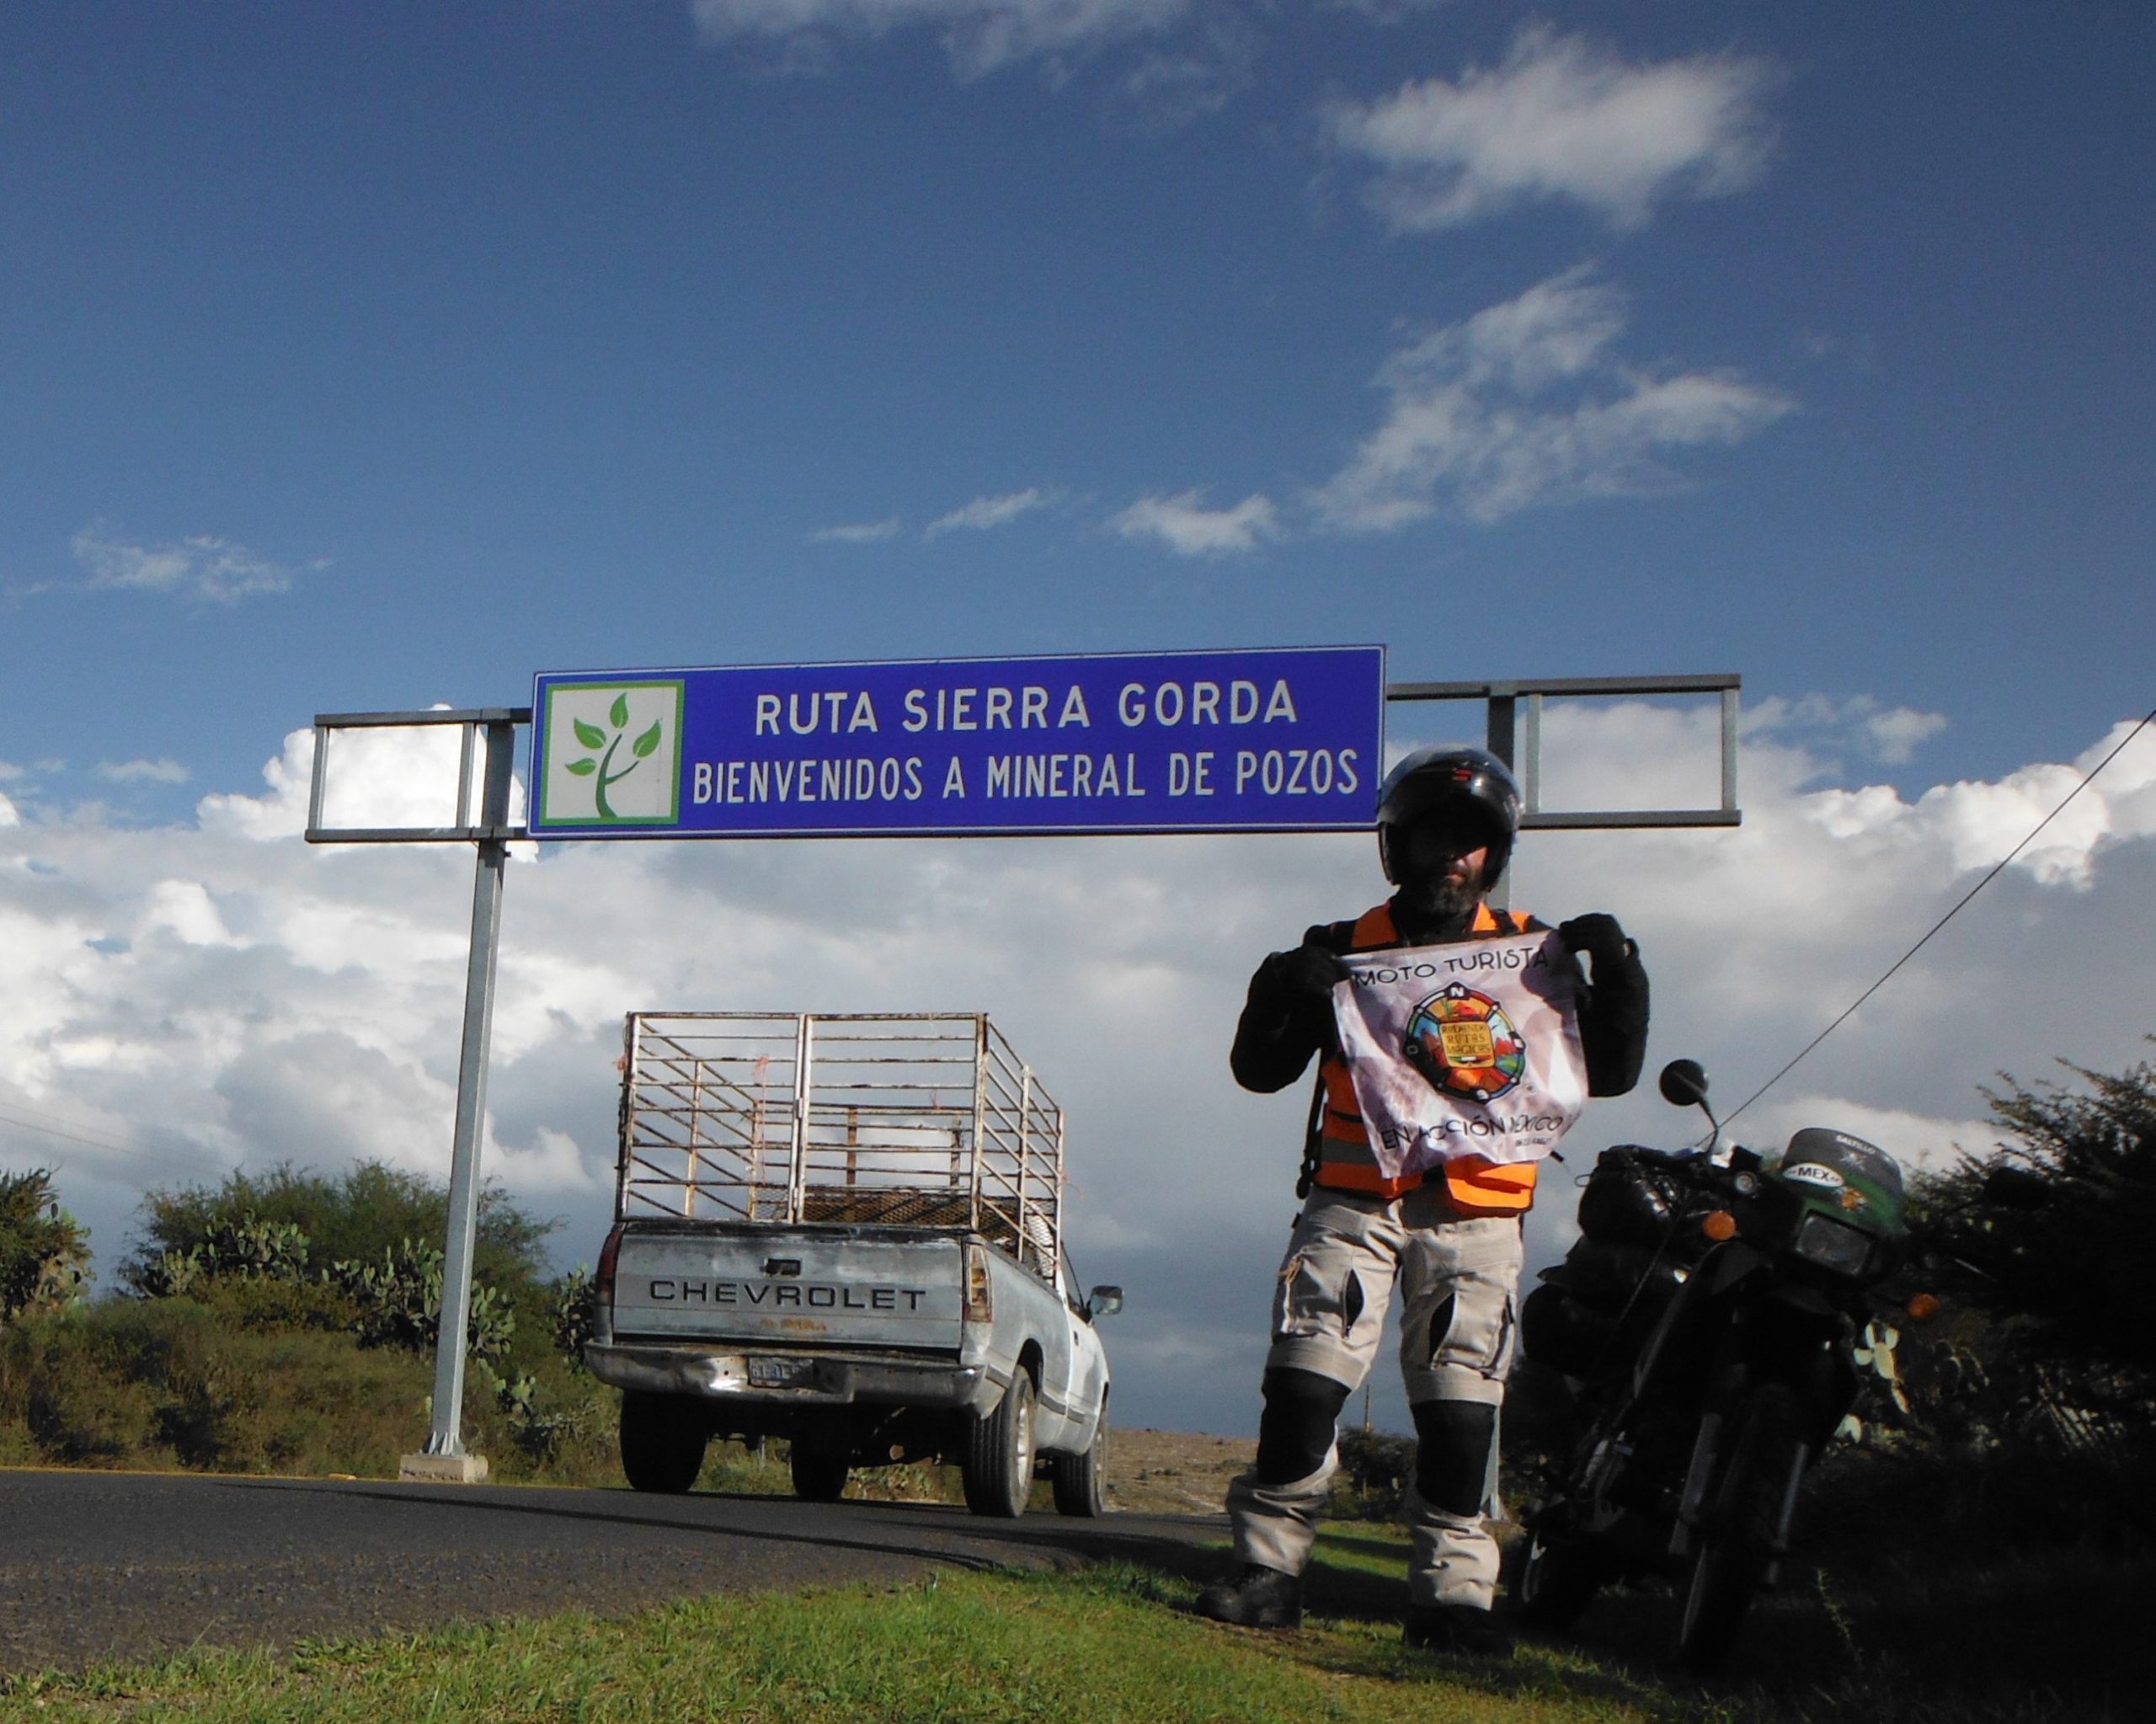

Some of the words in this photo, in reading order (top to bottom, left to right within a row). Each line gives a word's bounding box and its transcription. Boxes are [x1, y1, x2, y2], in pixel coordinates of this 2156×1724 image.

[755, 690, 879, 736] RUTA
[901, 684, 1091, 734] SIERRA
[1118, 678, 1299, 728] GORDA
[692, 755, 924, 805] BIENVENIDOS
[942, 755, 967, 799] A
[985, 751, 1147, 799] MINERAL
[1168, 750, 1215, 797] DE
[1235, 747, 1359, 796] POZOS
[1354, 963, 1436, 987] MOTO
[1444, 947, 1549, 973] TURISTA
[1450, 986, 1464, 997] N
[649, 1279, 927, 1311] CHEVROLET
